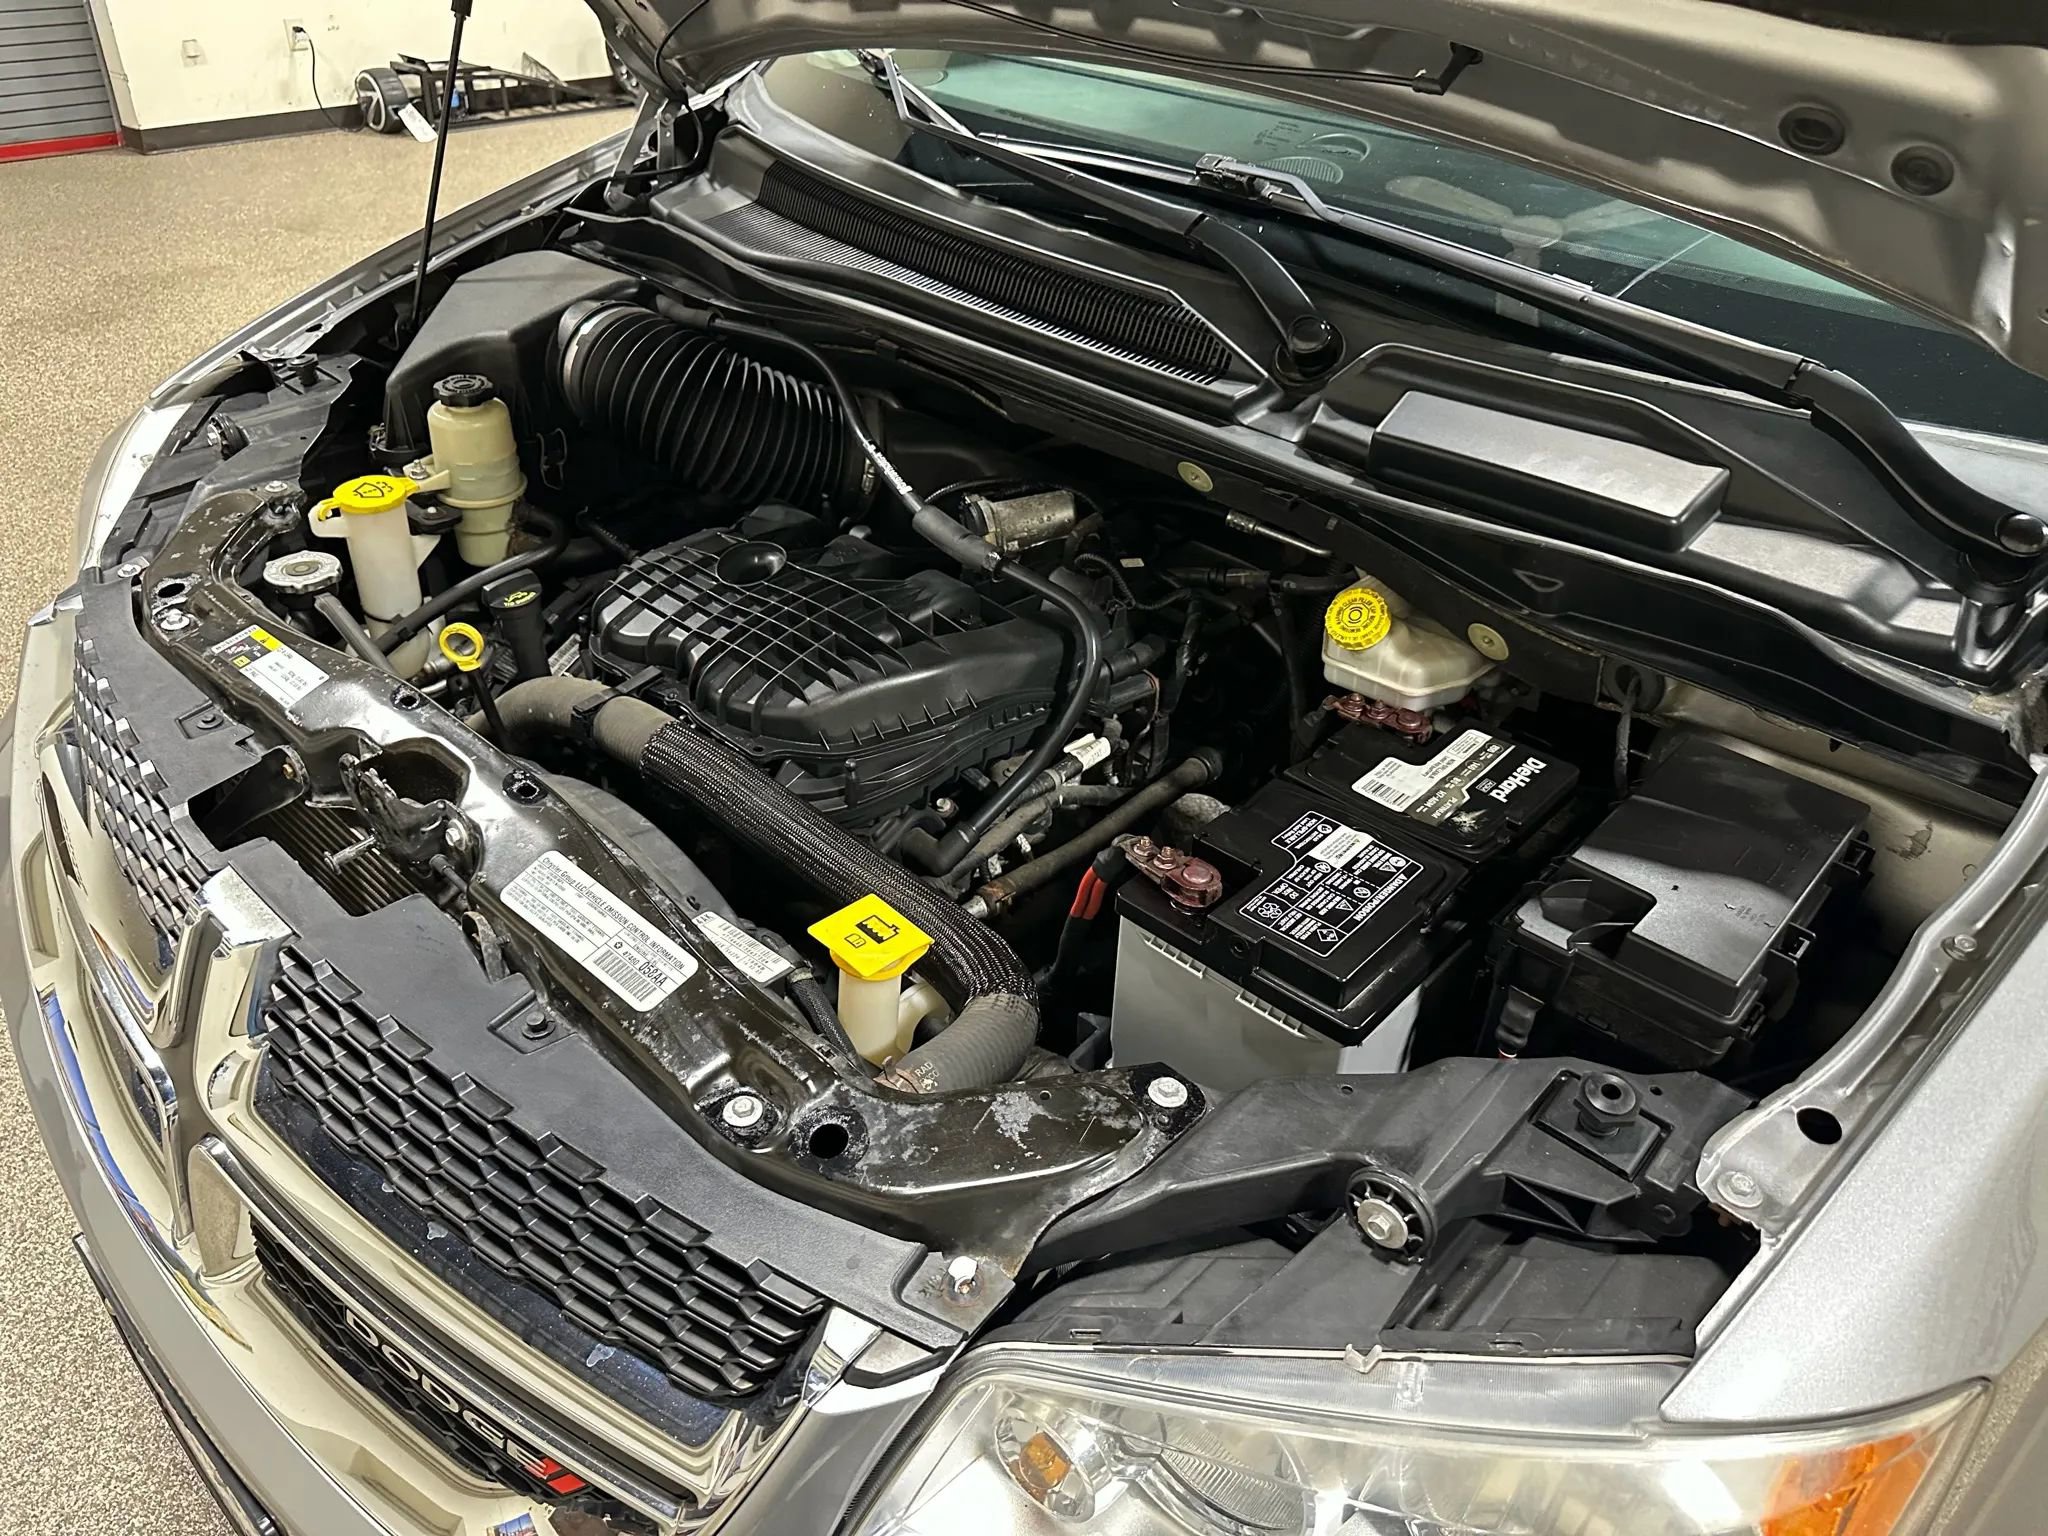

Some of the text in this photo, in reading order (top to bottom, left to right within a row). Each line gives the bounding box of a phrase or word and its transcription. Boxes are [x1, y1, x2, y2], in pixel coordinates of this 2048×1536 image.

[1488, 756, 1547, 802] DieHard
[1431, 797, 1457, 817] PLATINUM
[542, 856, 563, 874] Chrysler
[561, 871, 576, 885] Group
[575, 882, 586, 892] LLC
[585, 890, 605, 907] VEHICLE
[604, 905, 628, 925] EMISSION
[627, 923, 650, 943] CONTROL
[649, 940, 685, 970] INFORMATION
[1352, 878, 1403, 921] DANGER/POISON
[639, 960, 668, 987] 058AA
[915, 1062, 933, 1077] RAD
[346, 1308, 548, 1480] DODGE
